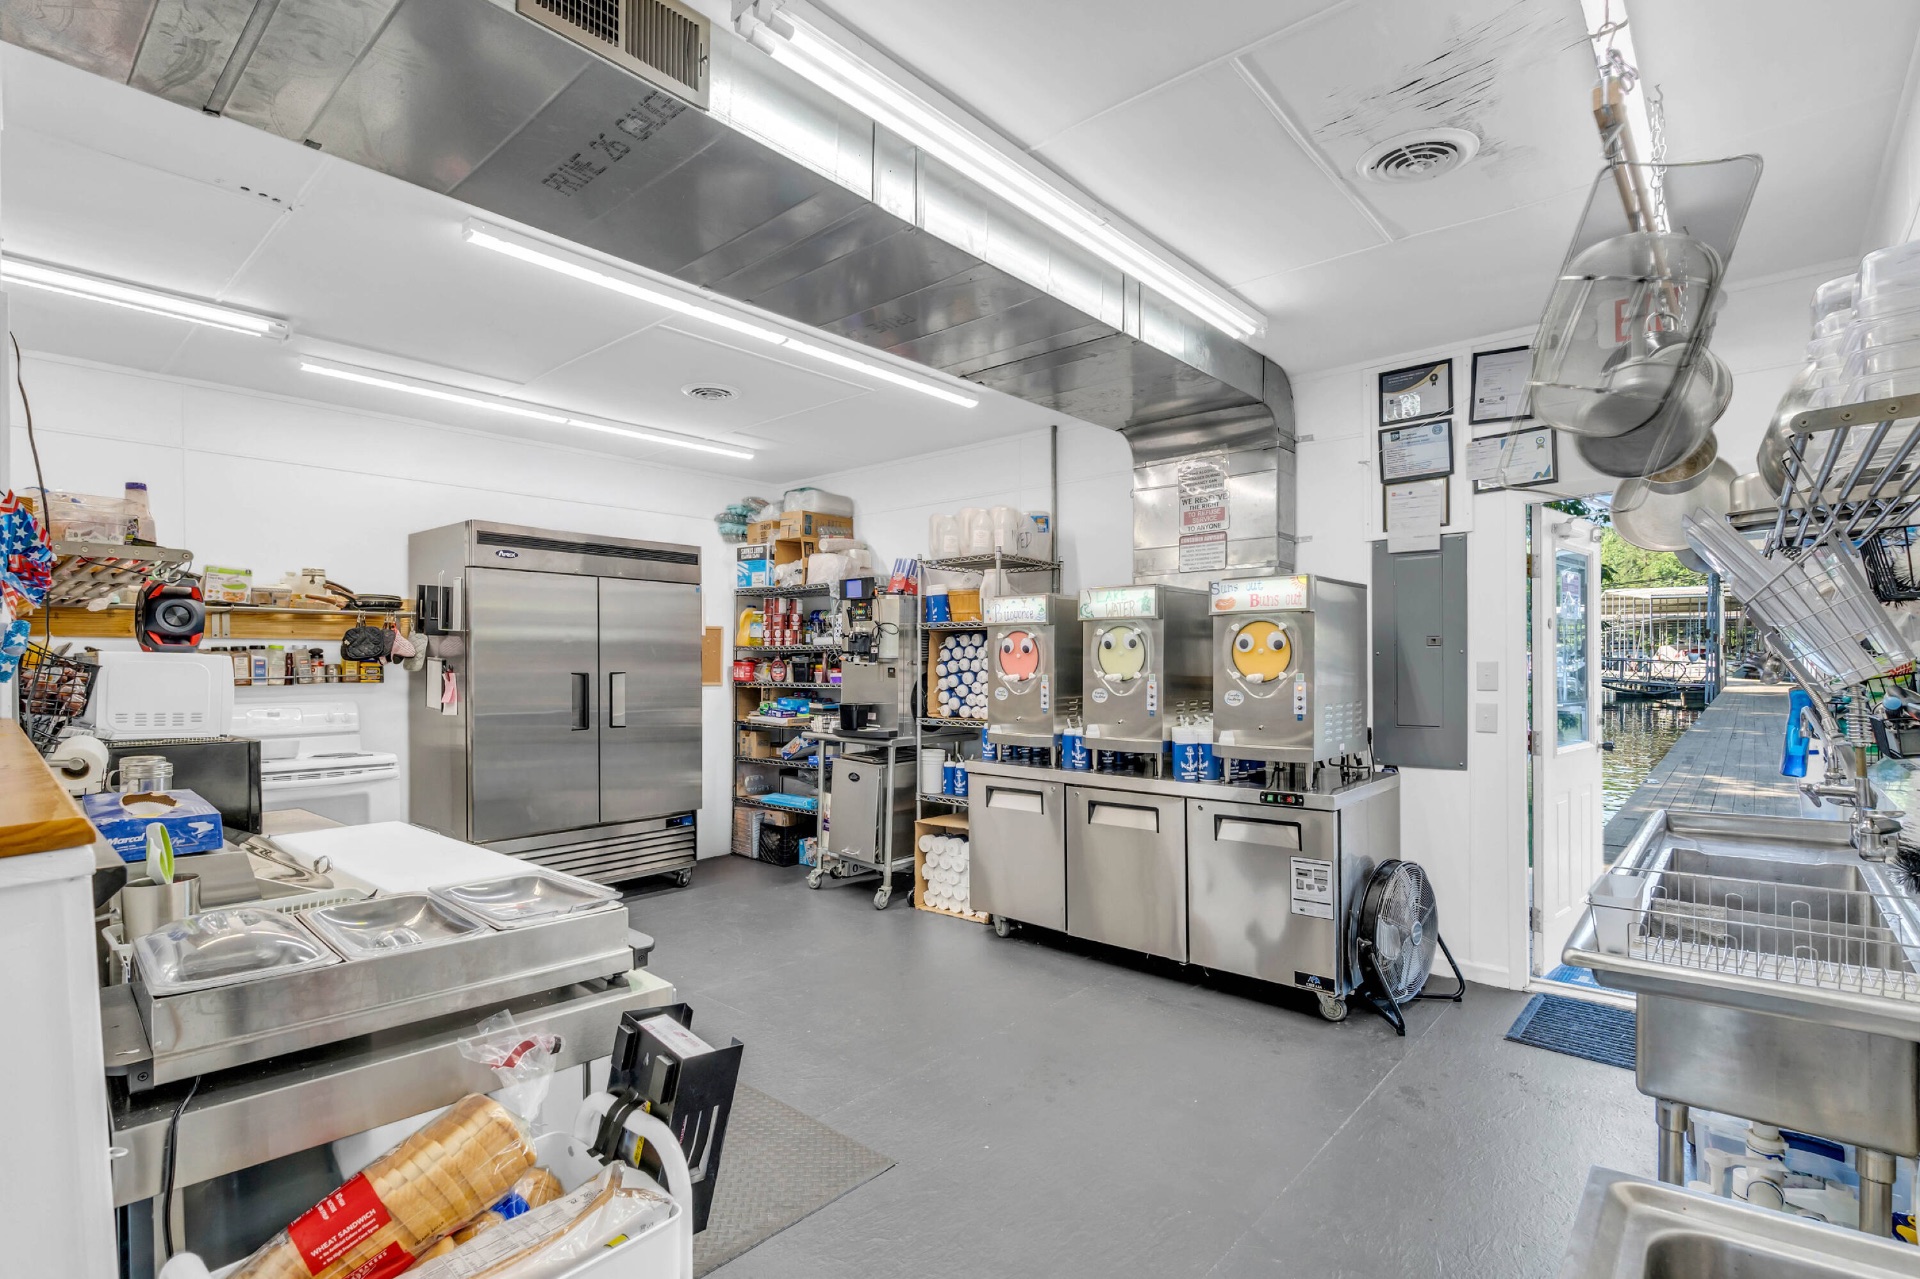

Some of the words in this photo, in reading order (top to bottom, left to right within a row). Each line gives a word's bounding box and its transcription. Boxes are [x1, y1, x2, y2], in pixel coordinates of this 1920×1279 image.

[1182, 498, 1192, 506] WE
[1202, 501, 1219, 509] RIGHT
[1197, 522, 1222, 530] ANYONE
[1211, 582, 1238, 595] Suns
[1249, 593, 1279, 608] Buns
[1285, 592, 1303, 606] out
[1105, 599, 1136, 618] WATER
[107, 832, 146, 846] Marcal
[310, 1235, 337, 1257] WHEAT
[337, 1208, 377, 1239] SANDWICH
